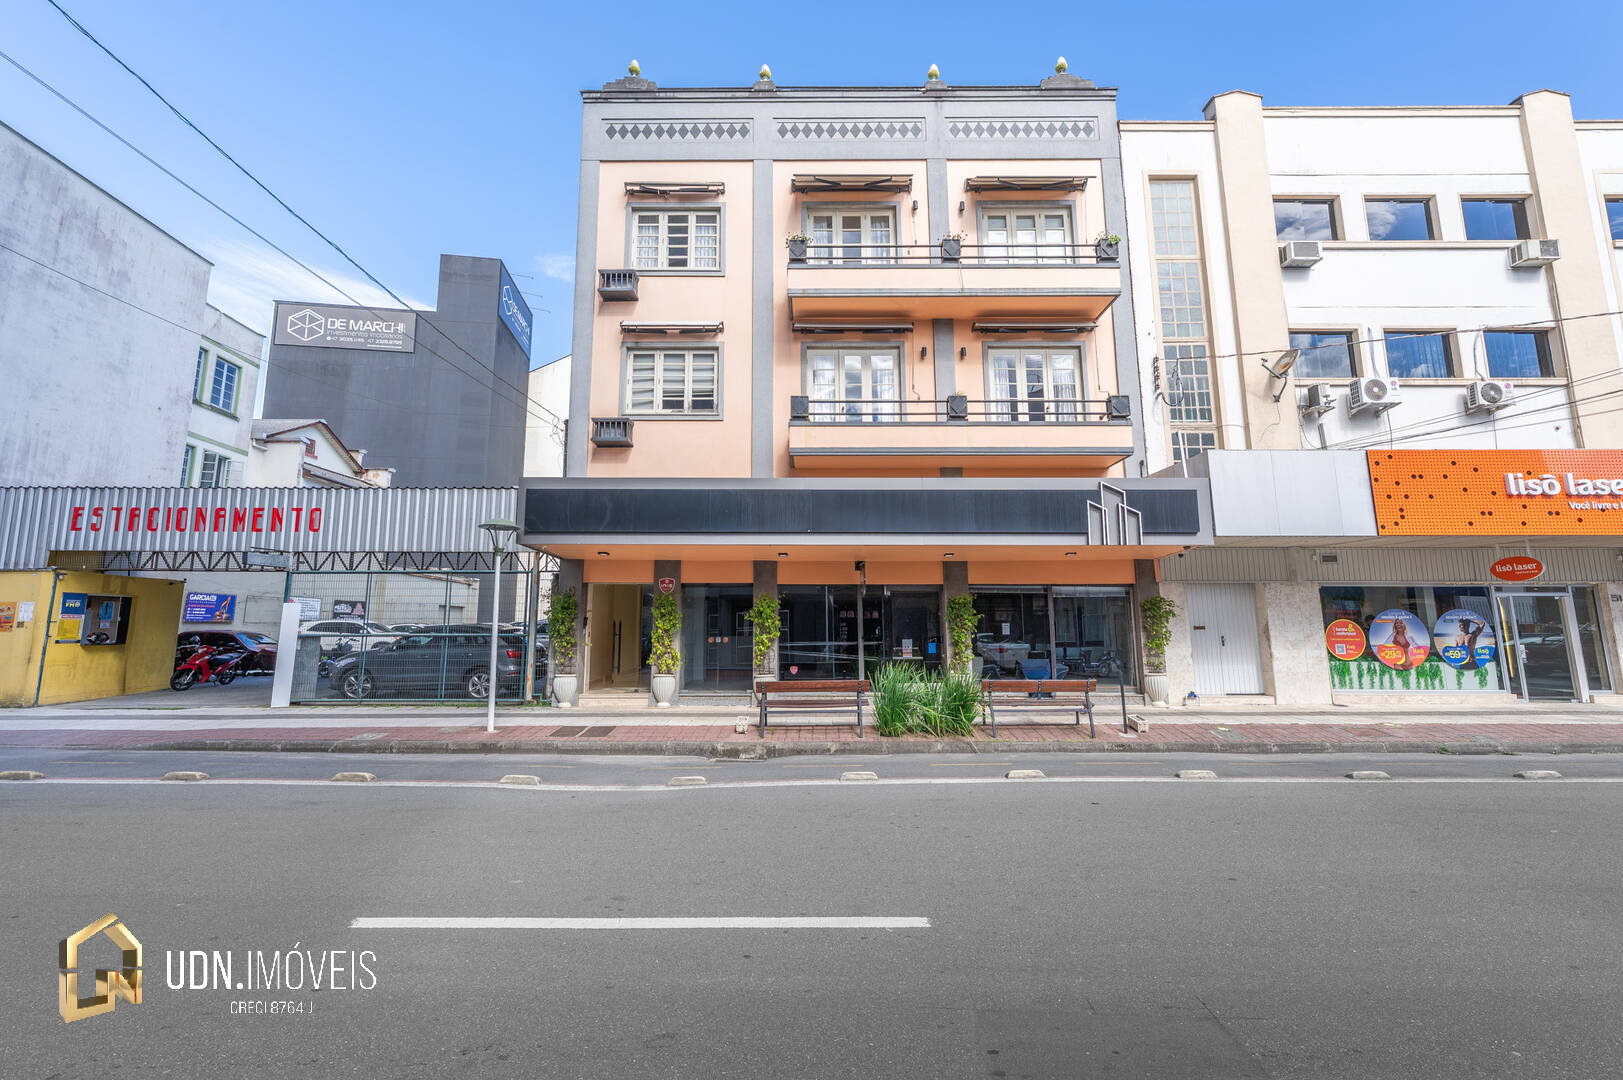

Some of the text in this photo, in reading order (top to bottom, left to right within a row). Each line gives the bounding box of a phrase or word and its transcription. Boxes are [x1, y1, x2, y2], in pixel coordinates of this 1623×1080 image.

[328, 318, 404, 334] DE MARCHI
[1569, 500, 1591, 510] Você
[1592, 501, 1612, 510] livre
[70, 506, 322, 533] ESTACIONAMENTO
[1513, 562, 1537, 571] laser
[1449, 650, 1461, 659] 59
